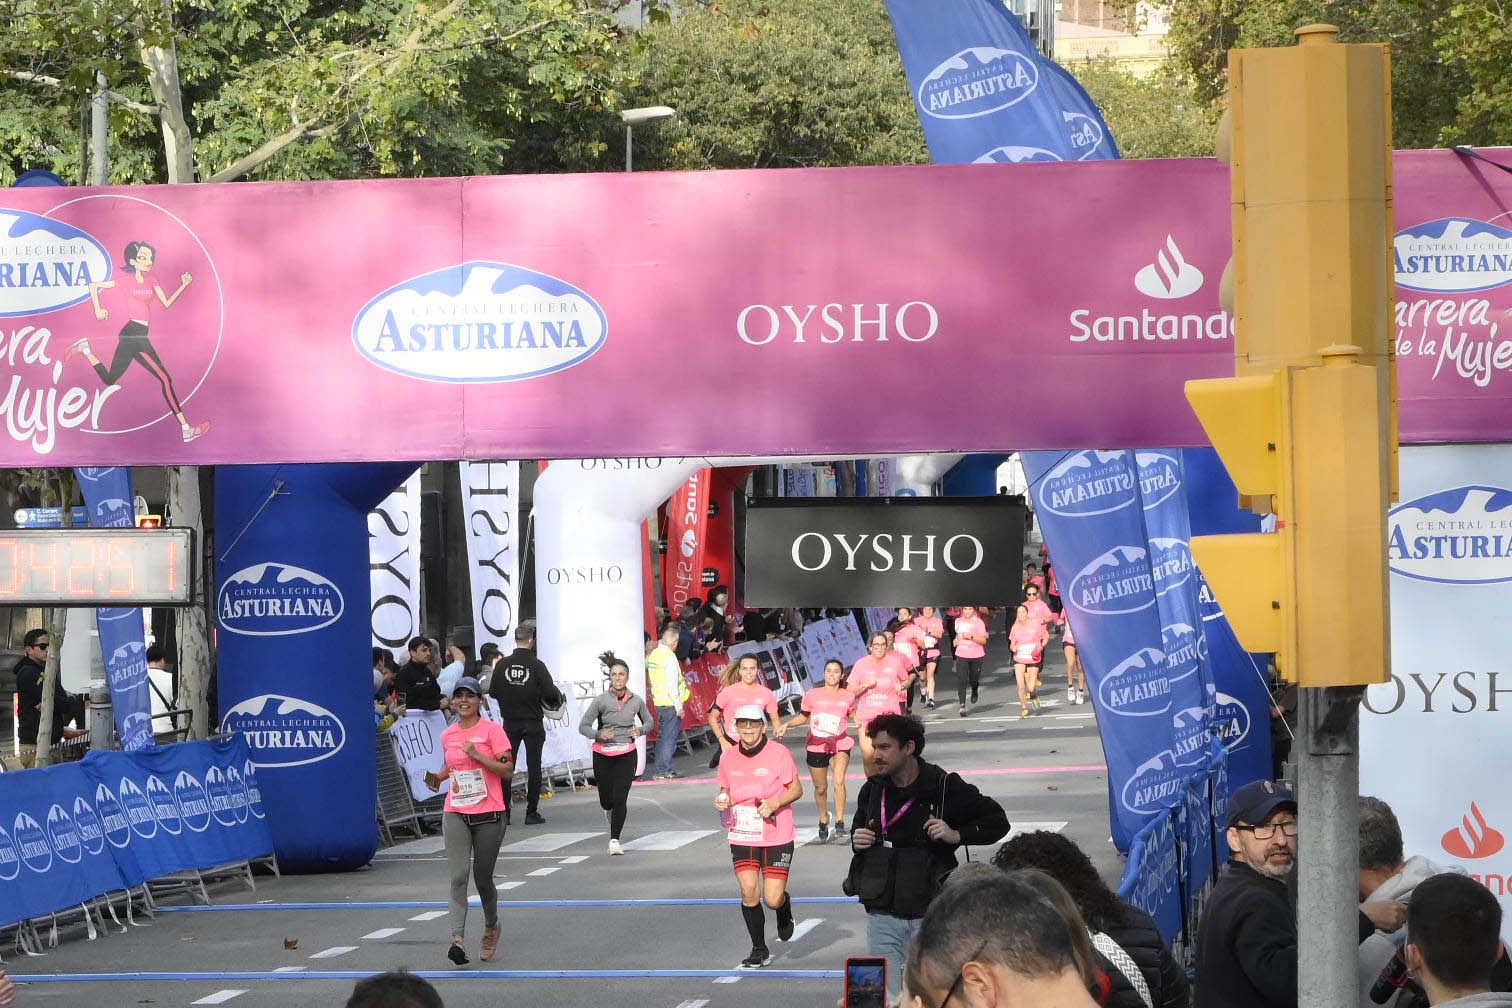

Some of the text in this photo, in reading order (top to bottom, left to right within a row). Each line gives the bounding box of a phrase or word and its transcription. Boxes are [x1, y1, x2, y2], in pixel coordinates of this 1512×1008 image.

[15, 245, 87, 257] LECHERA
[1409, 243, 1459, 251] CENTRAL
[736, 301, 939, 345] OYSHO
[1395, 299, 1490, 328] arrera
[373, 309, 587, 352] ASTURIANA
[1419, 329, 1436, 356] la
[1416, 519, 1483, 531] CENTRAL
[791, 532, 984, 572] OYSHO
[547, 565, 623, 585] OYSHO
[235, 588, 276, 596] CENTRAL
[222, 592, 334, 620] ASTURIANA
[511, 670, 523, 678] BP
[236, 720, 276, 728] CENTRAL
